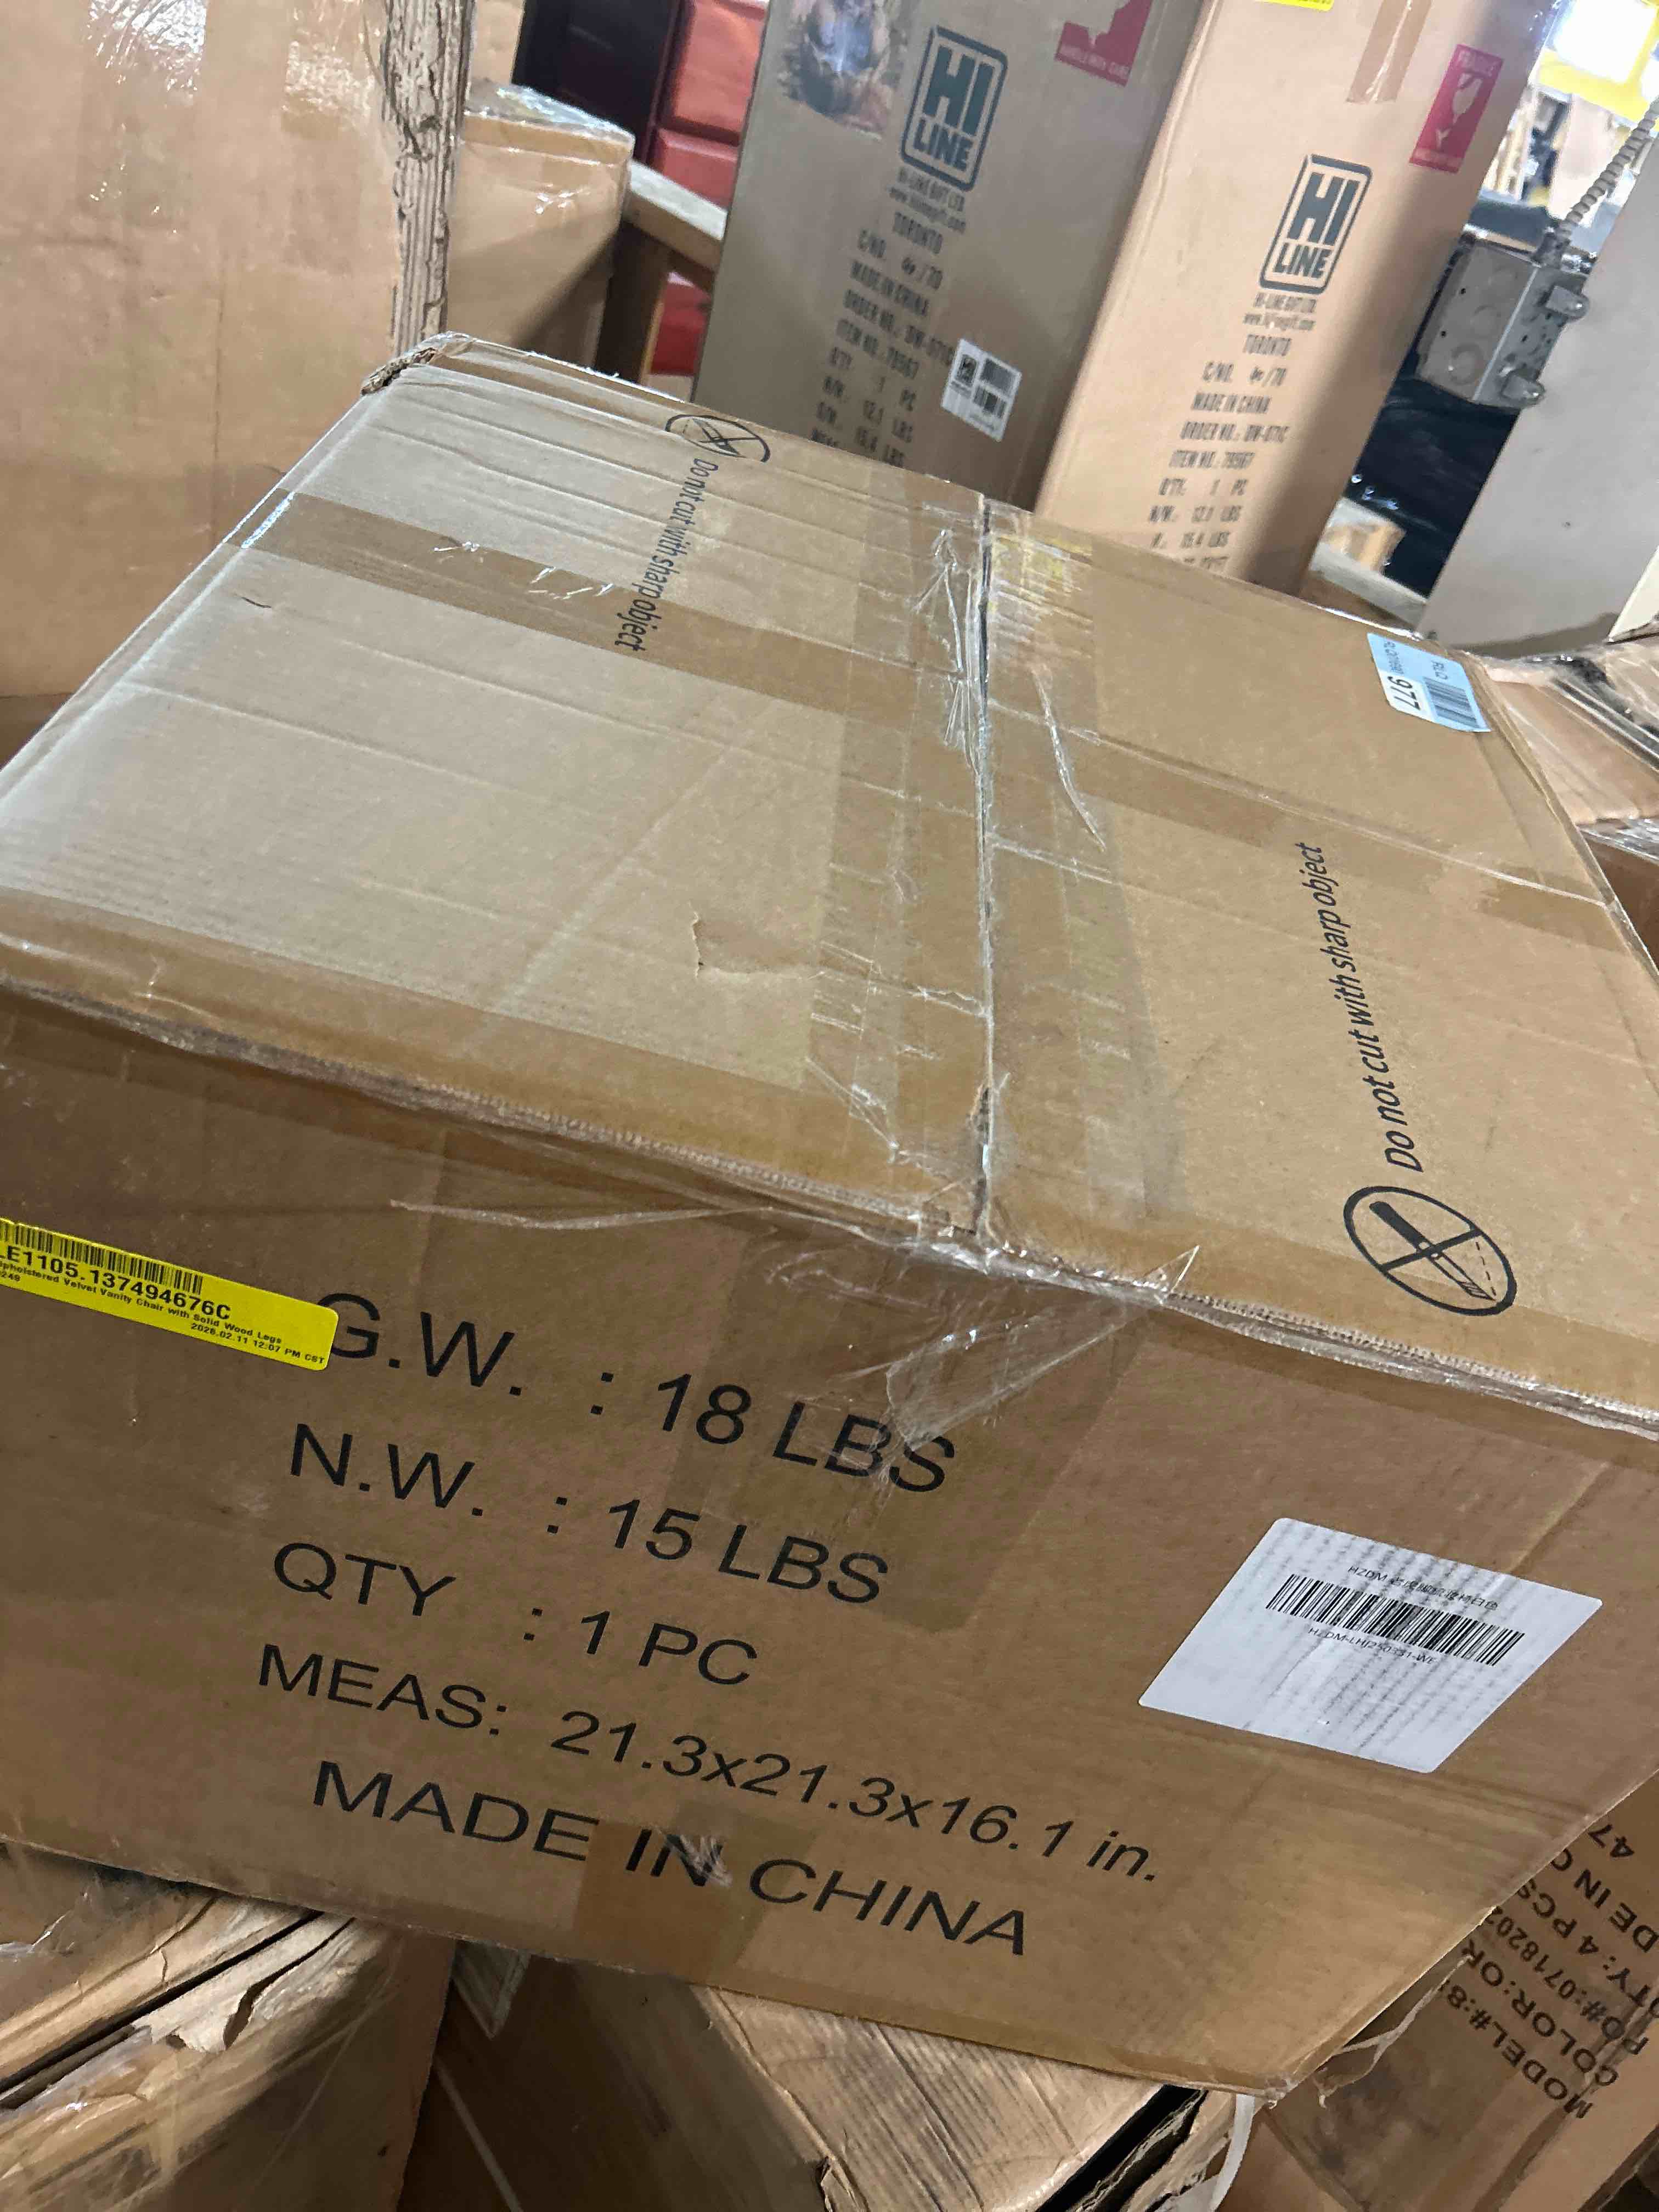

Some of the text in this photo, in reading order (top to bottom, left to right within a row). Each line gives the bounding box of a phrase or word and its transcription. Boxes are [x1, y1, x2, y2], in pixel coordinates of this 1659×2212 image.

[922, 46, 996, 135] HI
[913, 119, 975, 170] LINE
[1286, 171, 1359, 246] HI
[1273, 245, 1333, 280] LINE
[614, 458, 719, 652] Do not cut with sharp object
[1387, 675, 1421, 710] 977
[1295, 842, 1424, 1173] Do not cut with sharp object
[0, 1245, 232, 1319] E1105.137494676C
[64, 1278, 97, 1293] Velvet
[100, 1288, 132, 1304] Vanity
[136, 1297, 165, 1314] Chair
[167, 1307, 190, 1319] with
[193, 1313, 220, 1327] Solid
[224, 1323, 253, 1336] Wood
[257, 1331, 282, 1344] Legs
[284, 1348, 301, 1358] PM
[304, 1353, 325, 1364] CST
[317, 1293, 522, 1396] G.W.
[657, 1373, 752, 1445] 18
[772, 1401, 956, 1493] LBS
[290, 1423, 483, 1517] N.W.
[608, 1499, 701, 1561] 15
[719, 1525, 888, 1604] LBS
[273, 1542, 458, 1617] QTY
[580, 1611, 610, 1655] 1
[638, 1622, 758, 1686] PC
[258, 1643, 1156, 1881] MEAS: 21.3x21.3x16.1 in.
[313, 1759, 1028, 1956] MADE IN CHINA
[1573, 1869, 1611, 1909] IN
[1578, 1936, 1600, 1955] 4
[1438, 1979, 1593, 2119] MODEL#:8
